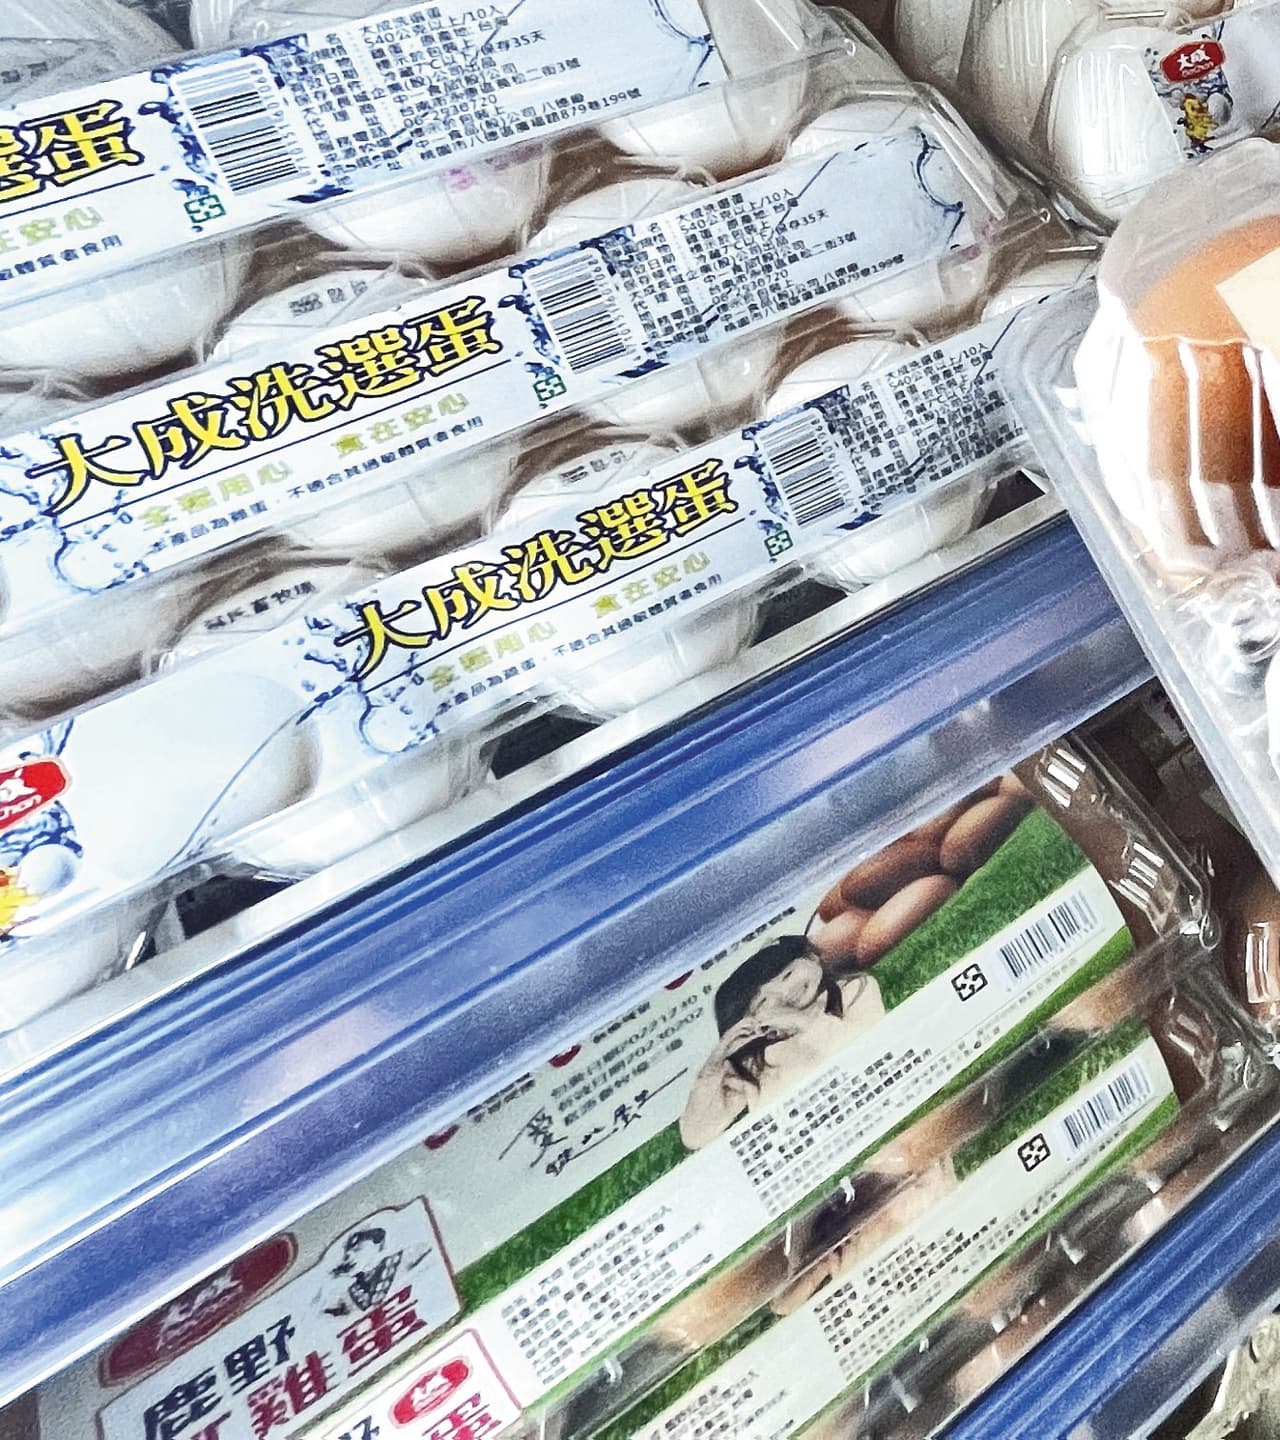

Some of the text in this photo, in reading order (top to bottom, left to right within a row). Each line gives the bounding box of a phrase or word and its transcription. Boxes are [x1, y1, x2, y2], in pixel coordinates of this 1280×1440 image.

[1177, 47, 1210, 71] 大成
[0, 98, 144, 201] 蛋
[25, 296, 502, 517] 大成洗選蛋
[335, 459, 738, 683] 大成洗選蛋
[143, 1314, 296, 1440] 鹿野
